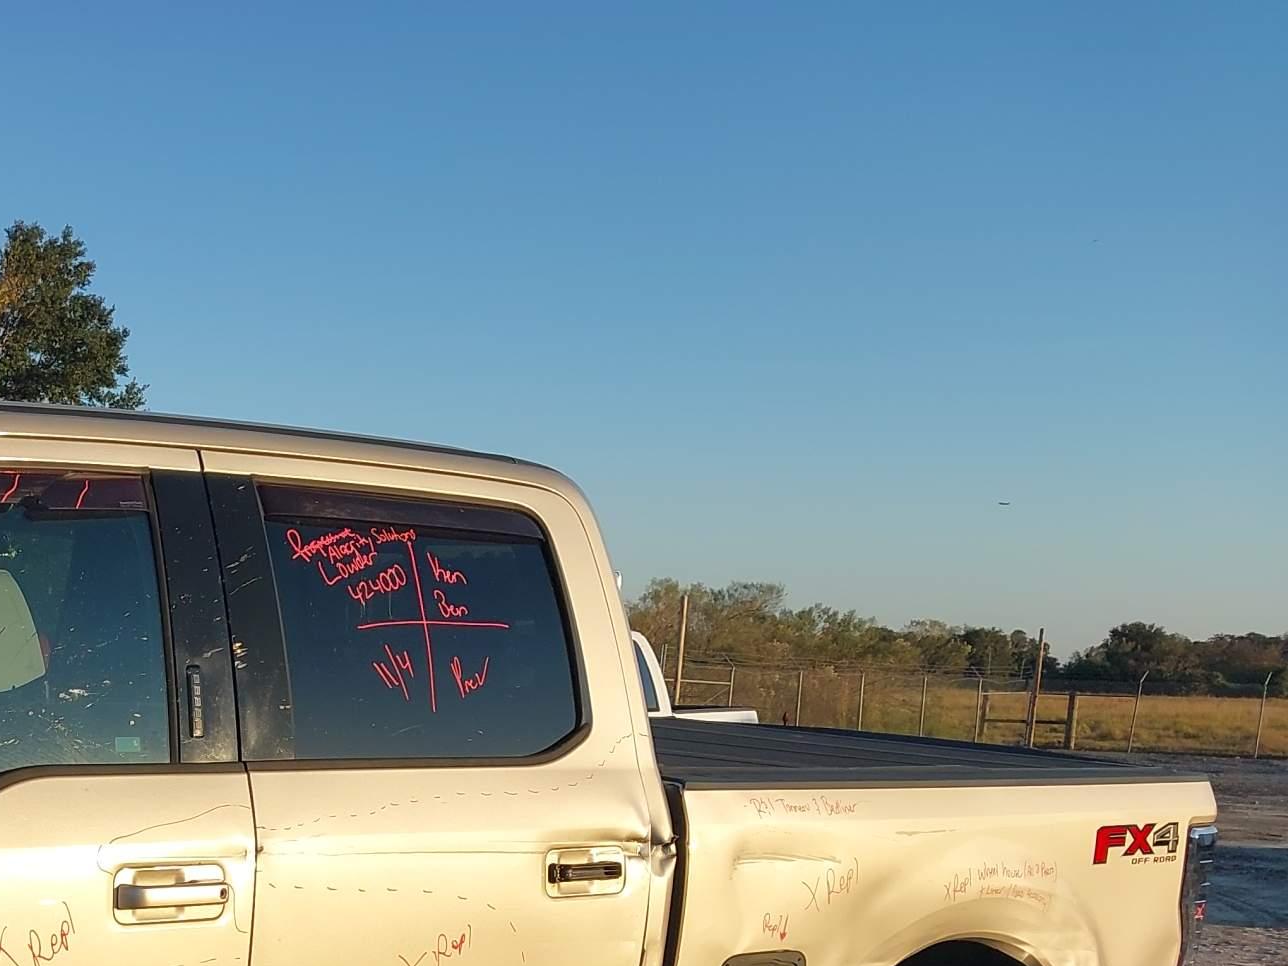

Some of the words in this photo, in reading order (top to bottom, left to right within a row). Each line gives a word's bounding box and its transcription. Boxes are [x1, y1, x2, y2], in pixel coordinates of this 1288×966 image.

[1093, 821, 1179, 865] FX4
[1131, 857, 1151, 865] OFF
[1153, 855, 1177, 864] ROAD
